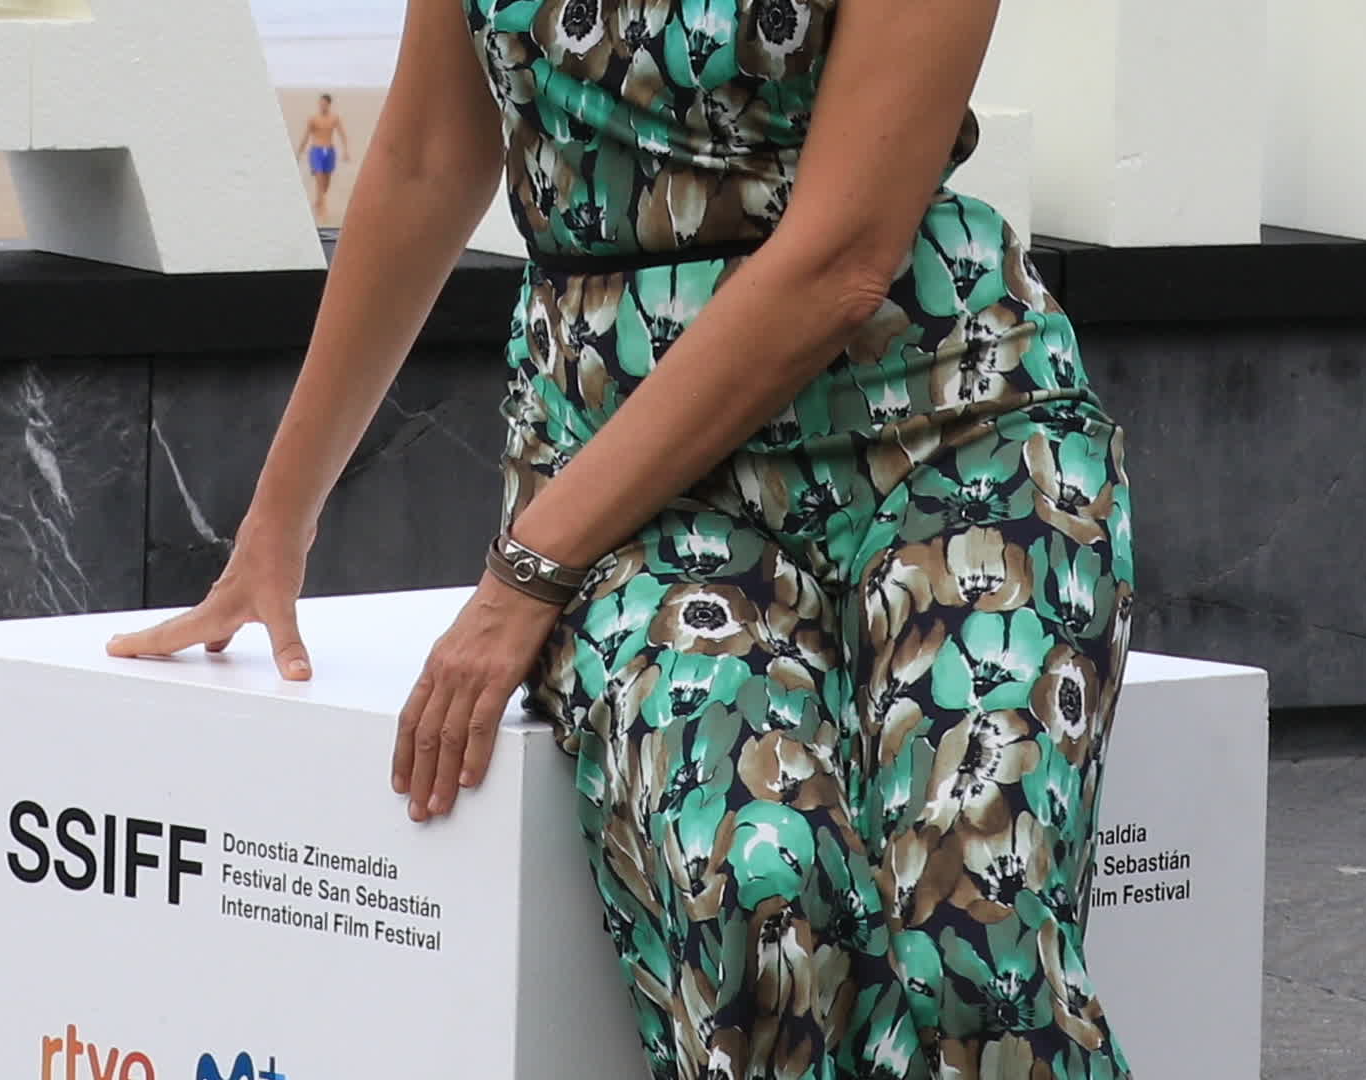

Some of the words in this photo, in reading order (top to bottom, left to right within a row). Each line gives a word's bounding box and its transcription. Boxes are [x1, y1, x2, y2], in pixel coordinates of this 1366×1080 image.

[6, 799, 208, 906] SSIFF
[222, 832, 300, 865] Donostia
[302, 845, 399, 881] Zinemaldia
[1103, 850, 1191, 876] Sebastián
[222, 864, 288, 894] Festival
[290, 873, 314, 898] de
[317, 879, 351, 905] San
[355, 885, 442, 920] Sebastián
[1091, 887, 1117, 907] ilm
[1123, 879, 1190, 905] Festival
[221, 894, 329, 932] International
[333, 913, 370, 940] Film
[374, 921, 442, 952] Festival
